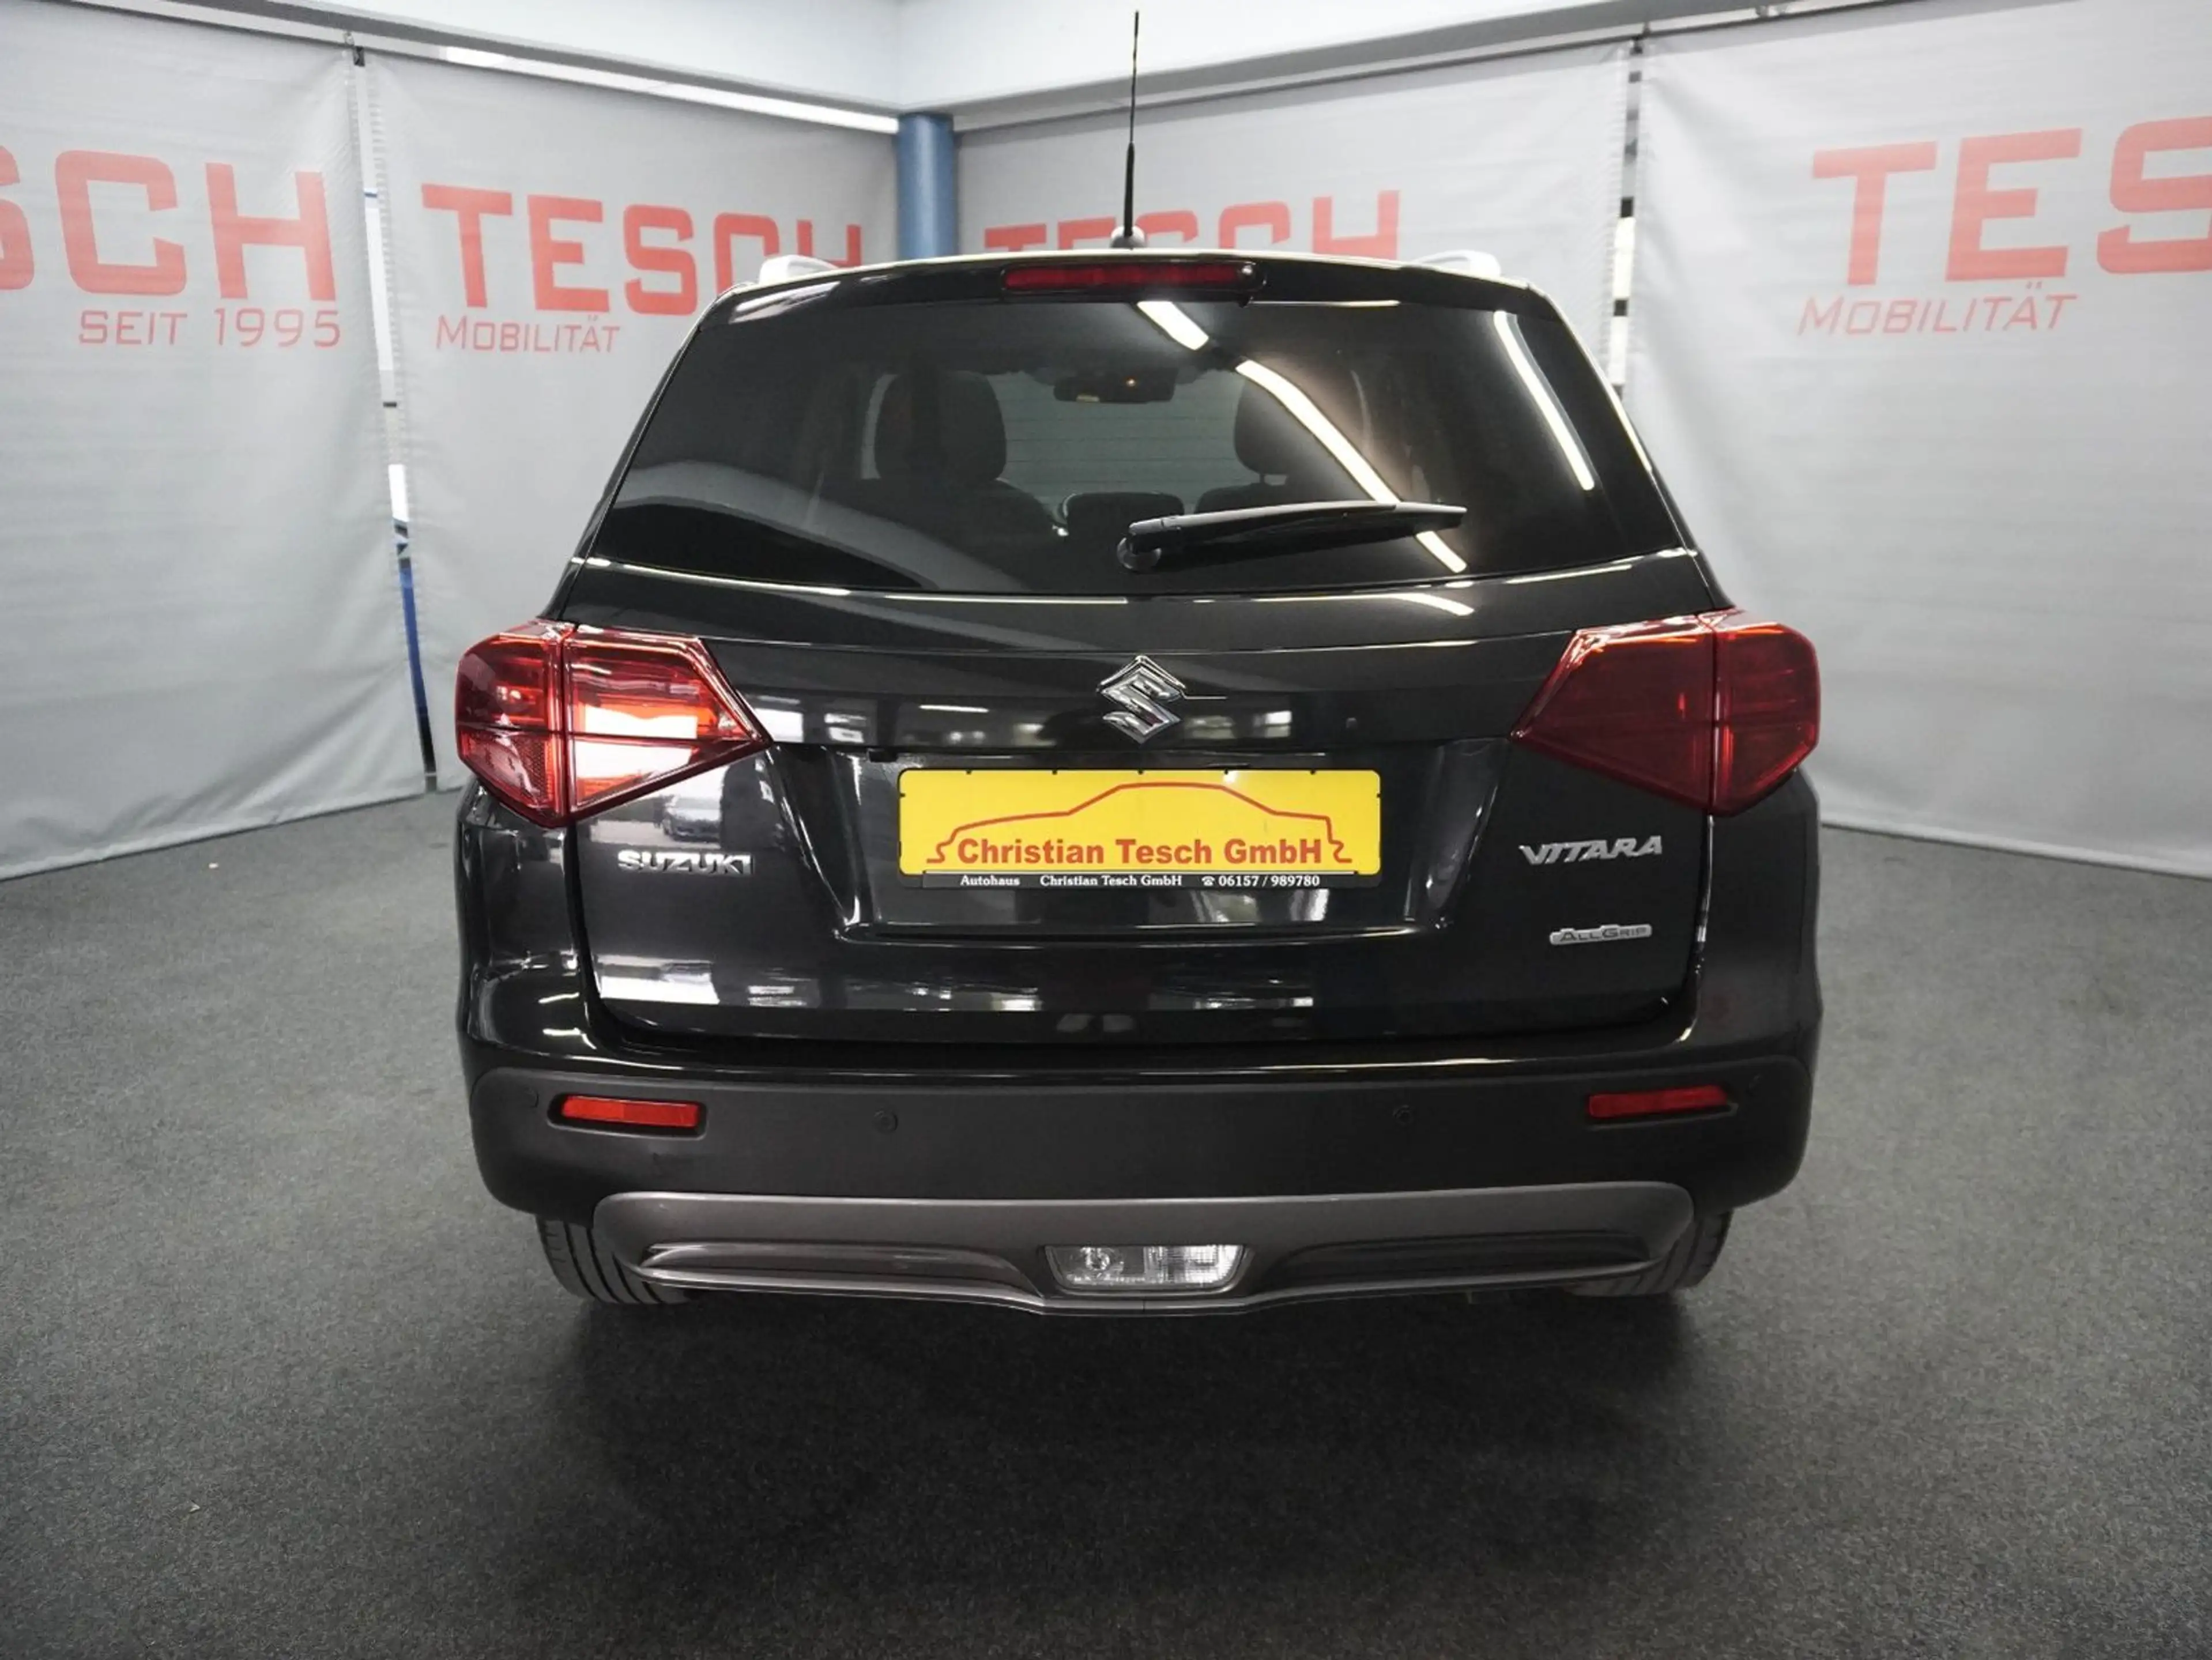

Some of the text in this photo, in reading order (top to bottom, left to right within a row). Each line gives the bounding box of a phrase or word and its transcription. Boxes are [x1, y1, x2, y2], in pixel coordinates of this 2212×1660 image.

[1797, 281, 2078, 337] MOBILITÄT
[78, 308, 341, 348] SEIT 1995
[435, 315, 620, 353] MOBILITÄT
[617, 849, 756, 874] SUZUKI
[958, 839, 1322, 864] Christian Tesch GmbH
[1518, 835, 1663, 865] VITARA
[960, 875, 1020, 886] Autohaus
[1040, 874, 1098, 886] Christian
[1101, 875, 1137, 886] Tesch
[1140, 875, 1182, 886] GmbH
[1218, 875, 1257, 886] 06157
[1271, 875, 1321, 886] 989780
